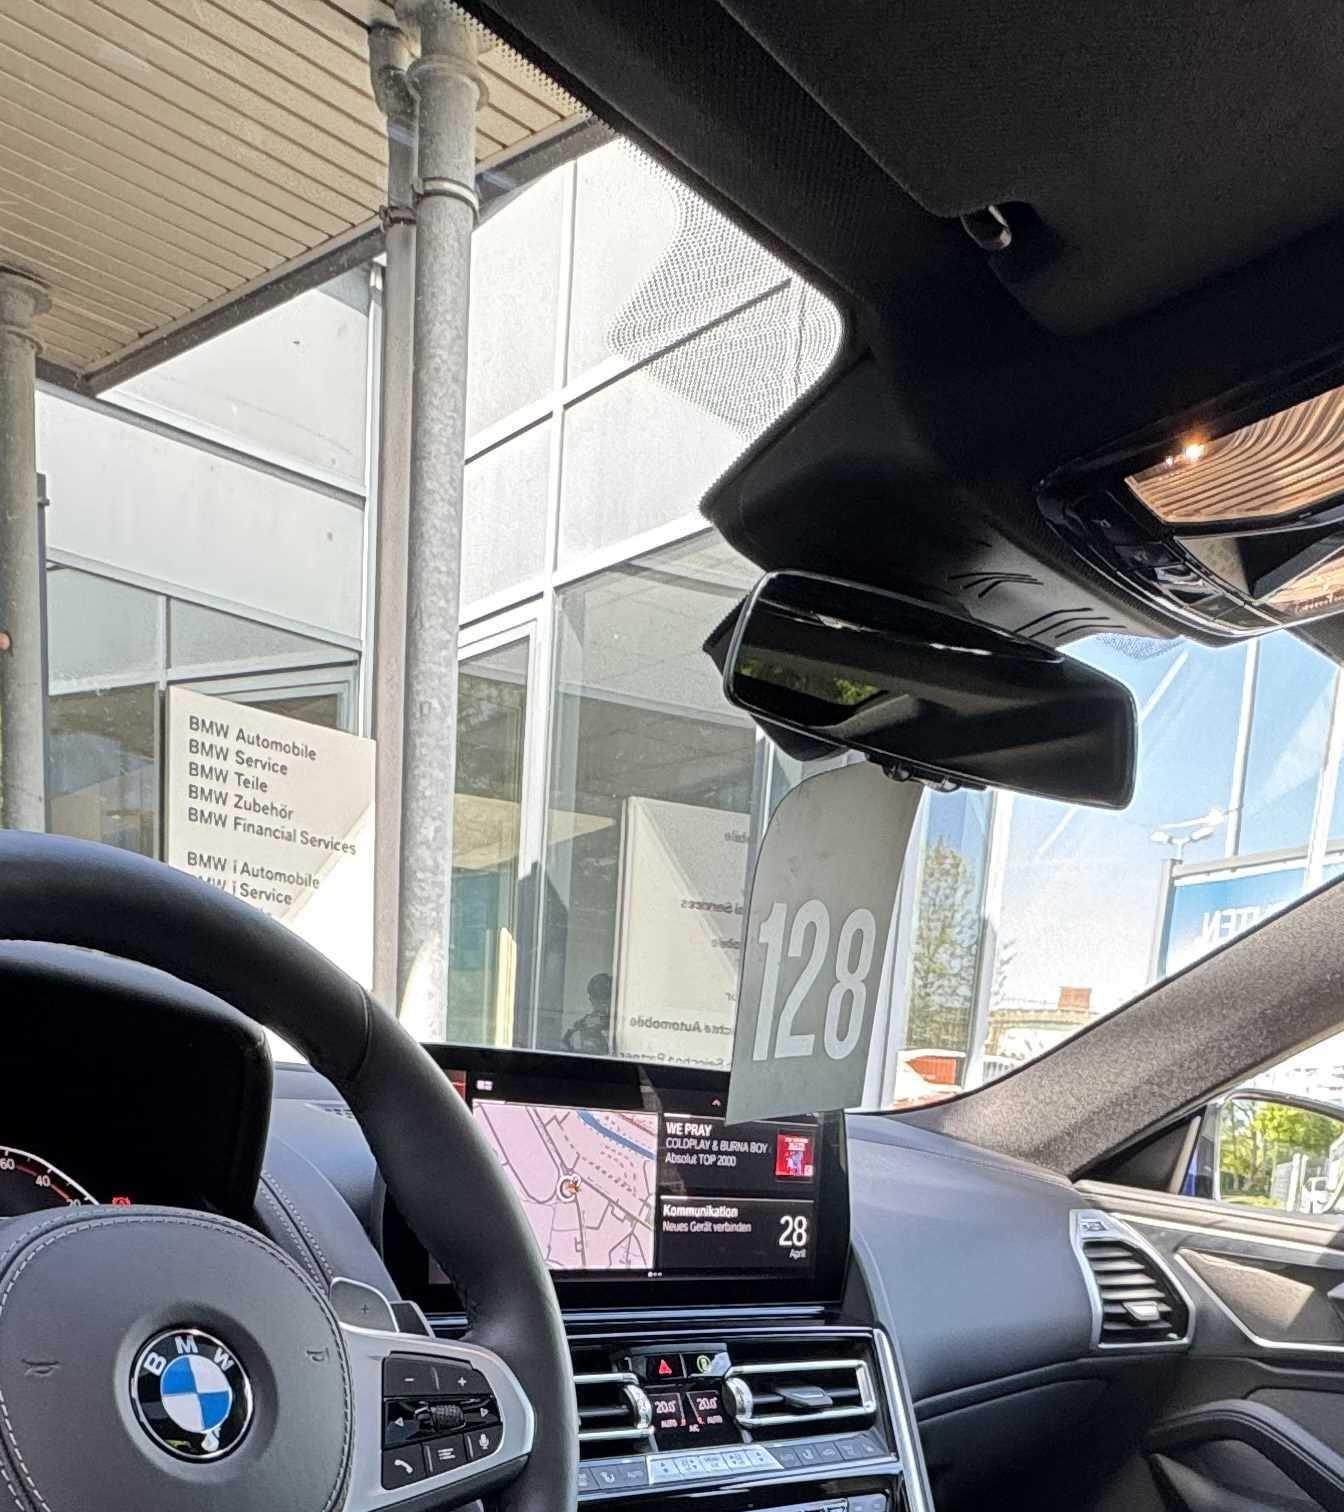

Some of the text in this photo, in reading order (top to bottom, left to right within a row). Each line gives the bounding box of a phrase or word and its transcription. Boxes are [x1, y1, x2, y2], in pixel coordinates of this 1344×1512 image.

[188, 715, 318, 762] BMW Automobile
[188, 739, 289, 776] BMW Service
[188, 762, 269, 794] BMW Teile
[187, 784, 295, 821] BMW Zubehör
[187, 807, 357, 856] BMW Financial Services
[187, 851, 227, 873] BMW
[232, 859, 238, 875] i
[240, 861, 321, 890] Automobile
[240, 882, 293, 906] Service
[753, 899, 877, 1062] 128
[666, 1122, 712, 1137] WE PRAY
[665, 1137, 769, 1154] COLDPLAY & BURNA BOY
[665, 1152, 699, 1165] Absolut
[699, 1154, 717, 1166] TOP
[0, 1158, 16, 1171] 60
[35, 1175, 52, 1188] 40
[663, 1204, 739, 1218] Kommunikation
[662, 1221, 689, 1232] Neues
[713, 1222, 752, 1233] verbinden
[778, 1215, 808, 1247] 28
[789, 1249, 807, 1260] April
[143, 1334, 236, 1377] BMW
